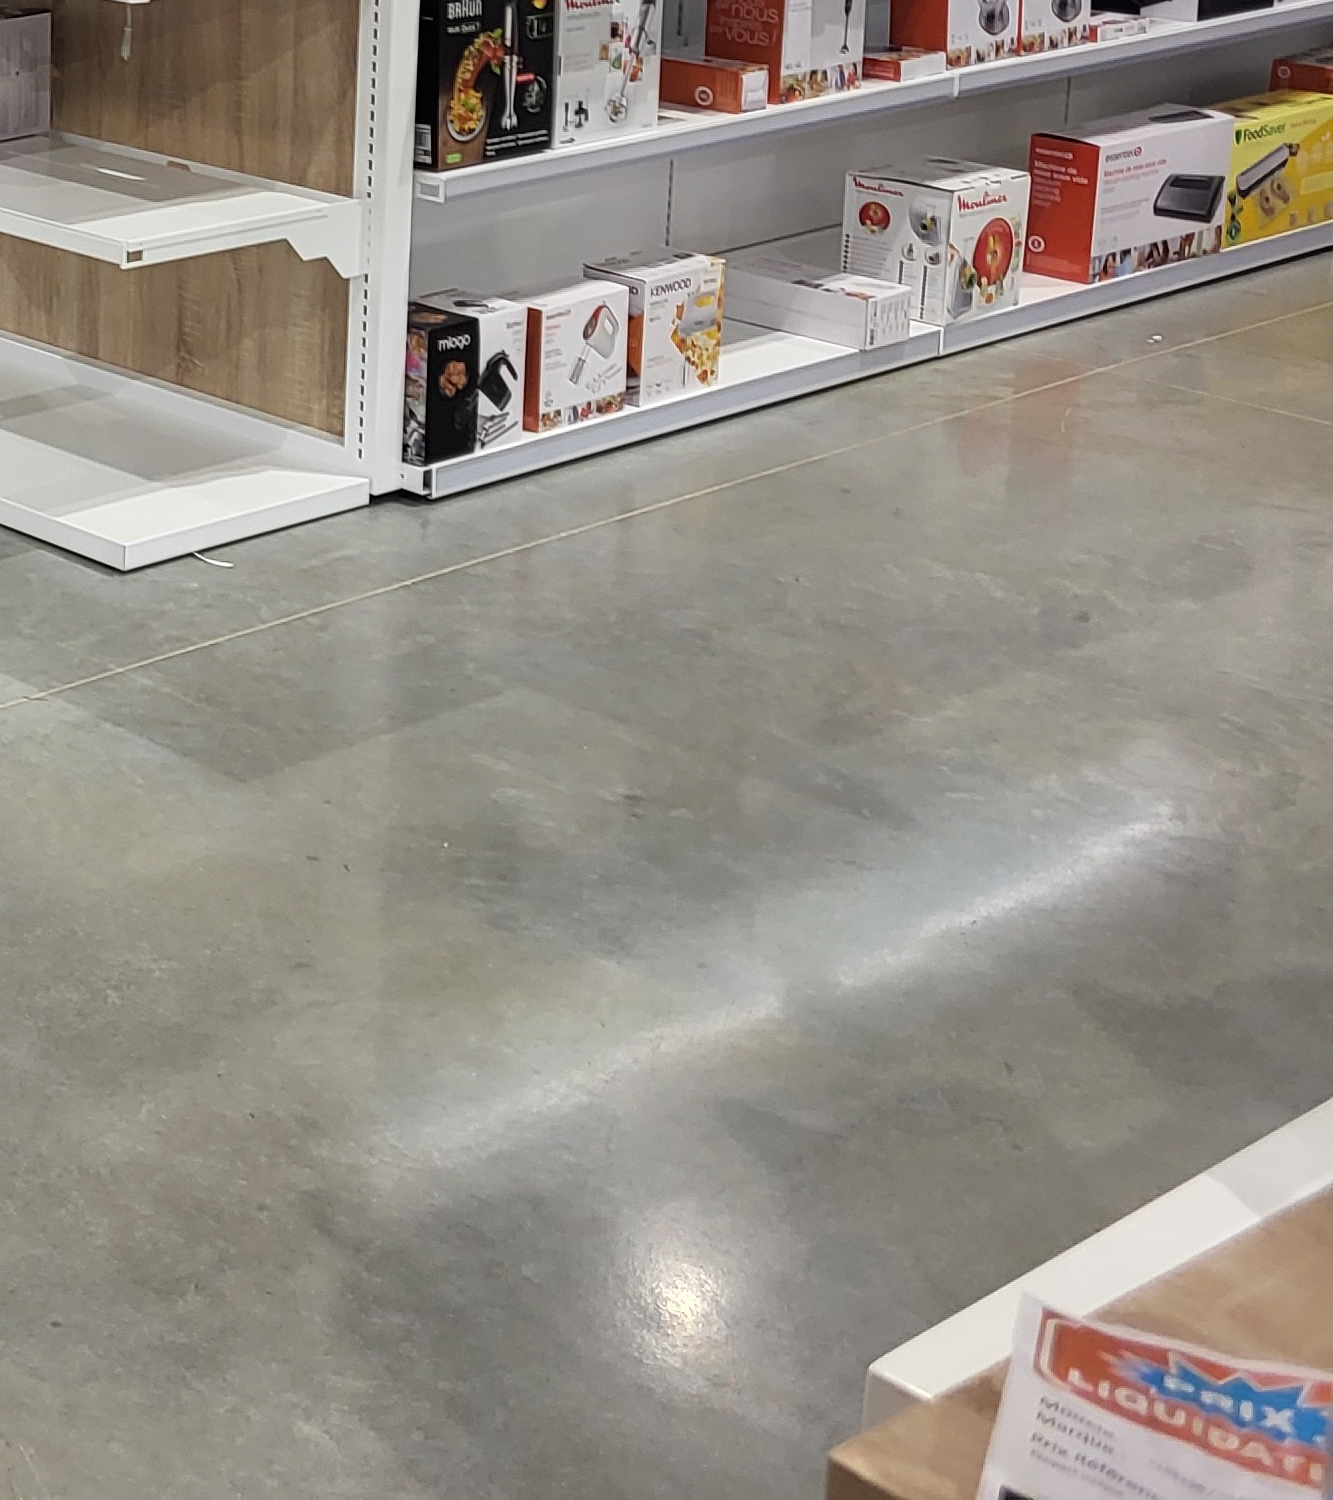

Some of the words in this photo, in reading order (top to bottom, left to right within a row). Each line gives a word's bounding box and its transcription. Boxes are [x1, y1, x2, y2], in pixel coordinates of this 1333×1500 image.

[732, 2, 780, 23] nous
[725, 27, 770, 47] vous
[1243, 124, 1286, 143] FoodSaver
[958, 189, 1008, 212] Moulinex
[650, 277, 692, 298] KENWOOD
[437, 334, 471, 352] miogo
